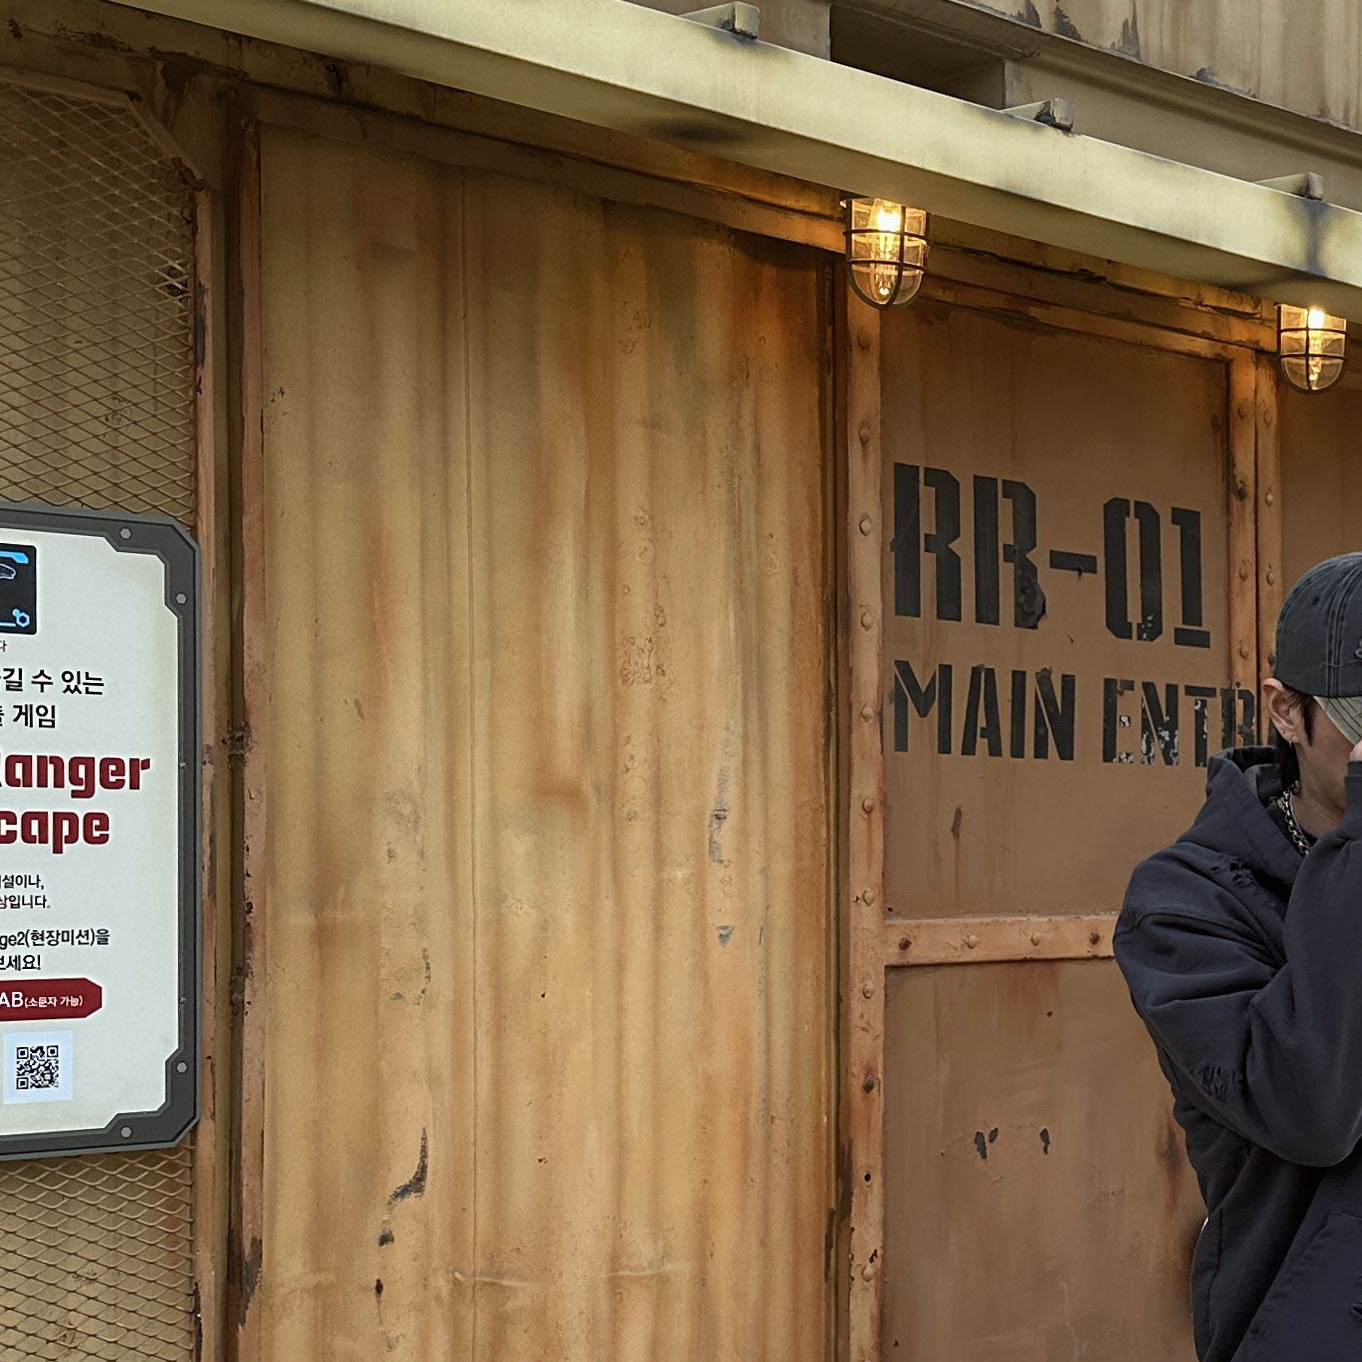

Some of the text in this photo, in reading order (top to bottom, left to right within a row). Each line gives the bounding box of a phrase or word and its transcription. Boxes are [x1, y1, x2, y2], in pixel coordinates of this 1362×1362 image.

[893, 462, 1211, 648] RR-01
[0, 667, 105, 696] 길 수 있는
[12, 703, 56, 729] 게임
[893, 658, 1076, 761] MAIN
[1102, 675, 1280, 768] ENTR
[0, 754, 151, 799] anger
[0, 874, 45, 890] 설이나,
